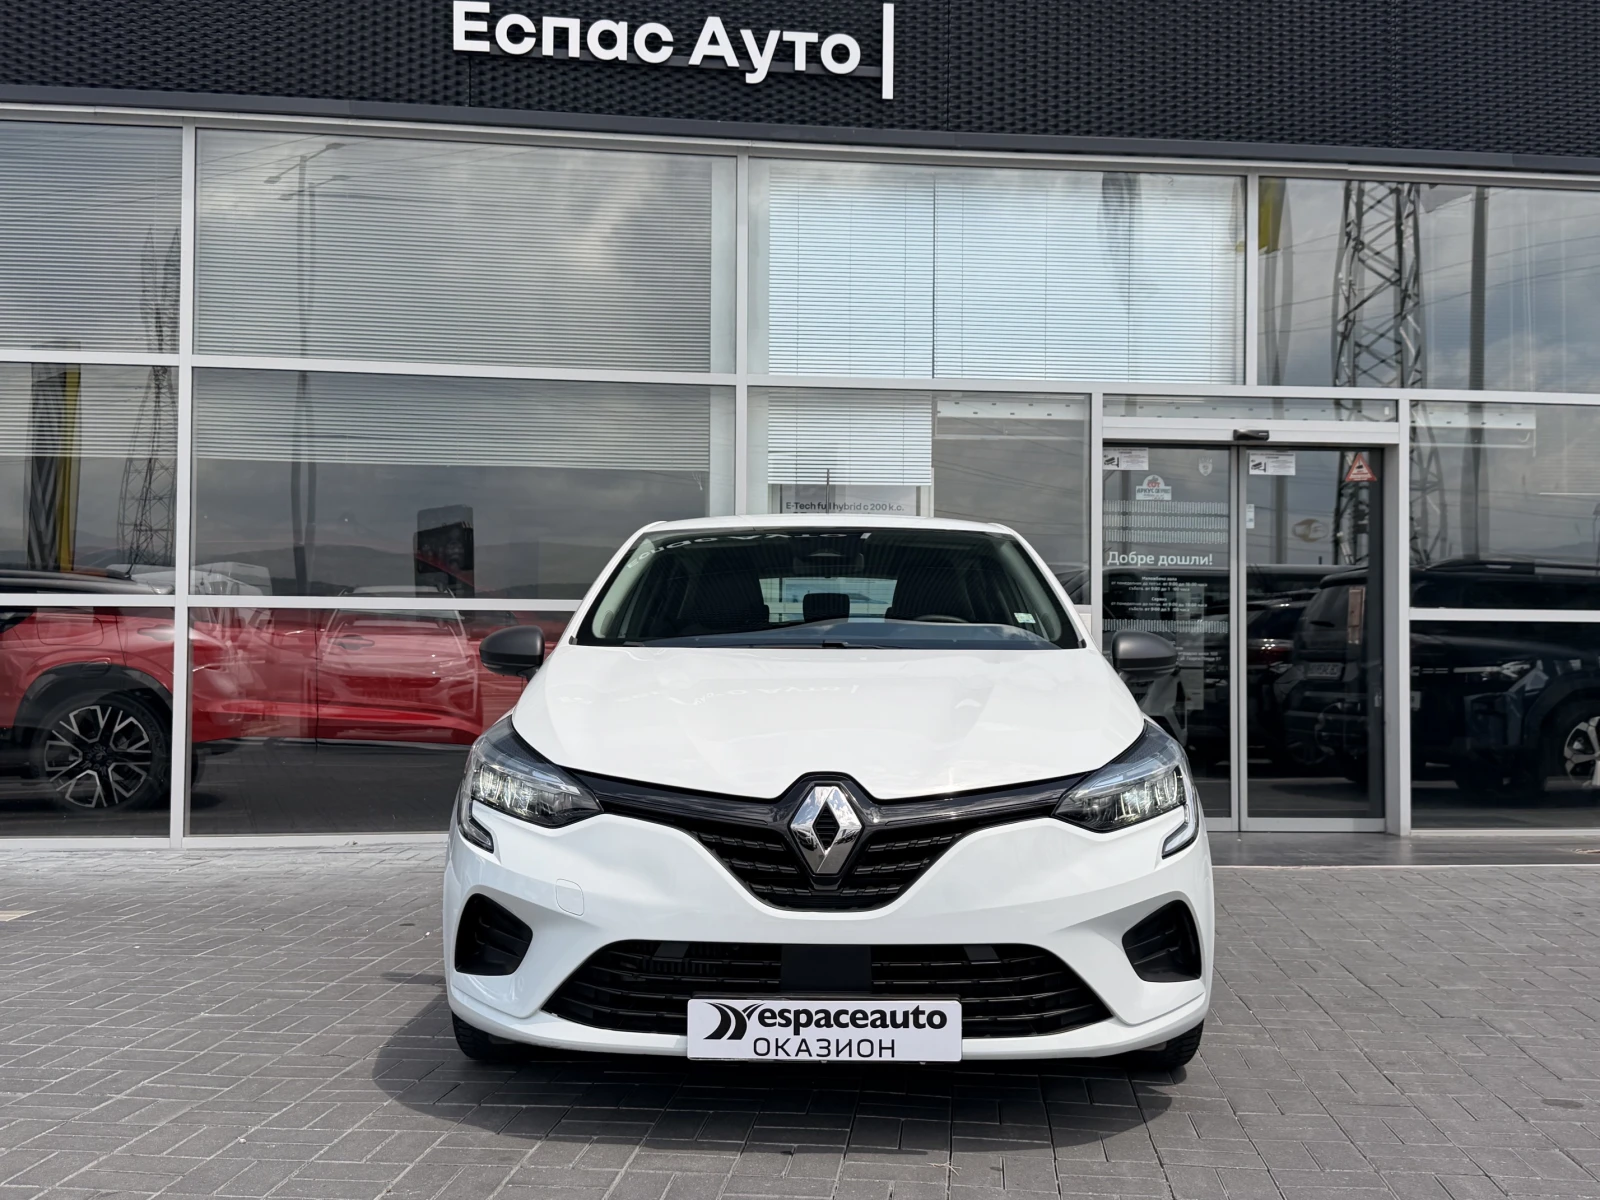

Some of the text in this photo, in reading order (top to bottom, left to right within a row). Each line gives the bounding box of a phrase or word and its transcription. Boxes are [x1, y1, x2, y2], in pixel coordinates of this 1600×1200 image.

[452, 0, 862, 85] Еспас Ауто
[785, 501, 815, 510] E-Tech
[834, 502, 861, 512] hybrid
[870, 503, 887, 511] 200
[1106, 551, 1213, 567] Добре дошли!
[757, 1004, 948, 1036] espaceauto
[753, 1037, 896, 1059] ОКАЗИОН
